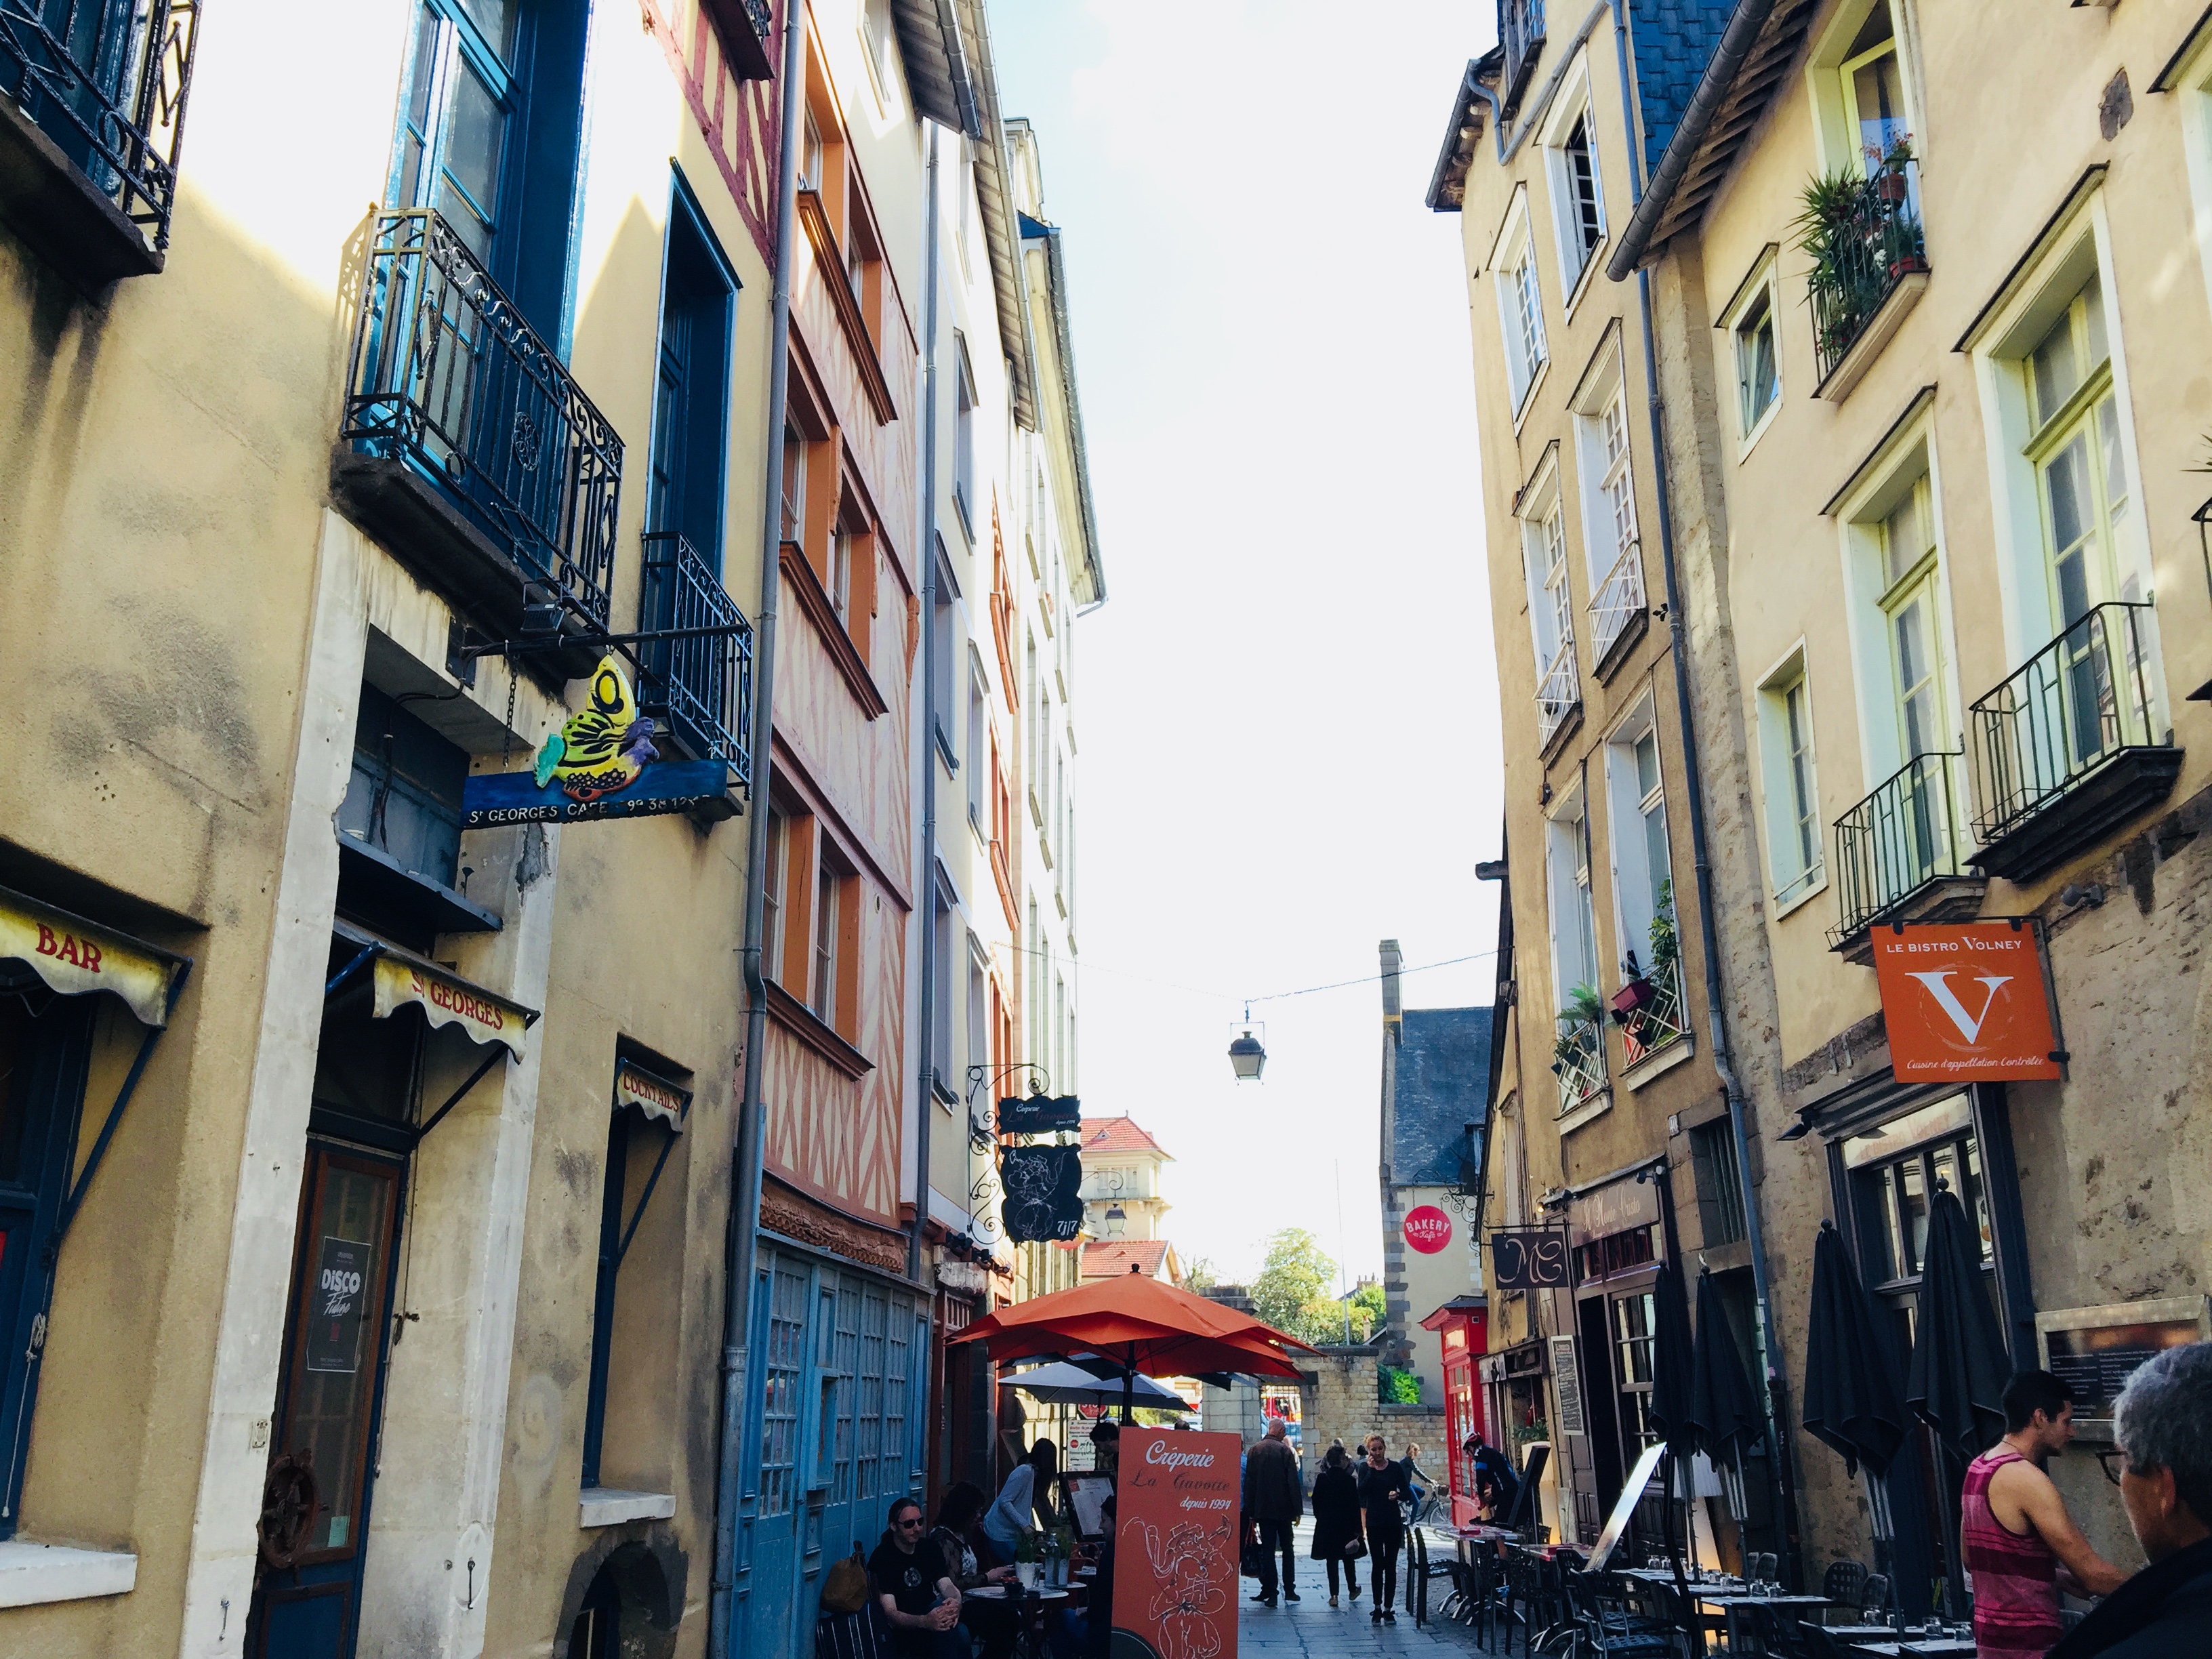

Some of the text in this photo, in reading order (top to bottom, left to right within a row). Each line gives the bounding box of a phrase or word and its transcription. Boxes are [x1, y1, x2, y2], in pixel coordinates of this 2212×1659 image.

[488, 805, 558, 822] GEORGES
[35, 922, 102, 973] BAR
[1887, 937, 2022, 953] LE BISTRO VOLNEY
[430, 982, 504, 1031] GEORGES
[1905, 971, 2014, 1044] V
[1907, 1059, 1938, 1069] Cuisine
[623, 1073, 678, 1112] COCKTAILS
[1057, 1220, 1078, 1236] 7j/7
[1406, 1218, 1450, 1233] BAKERY
[1145, 1439, 1215, 1473] Crêperie
[1130, 1469, 1157, 1488] La
[1179, 1496, 1232, 1511] depuis 1994
